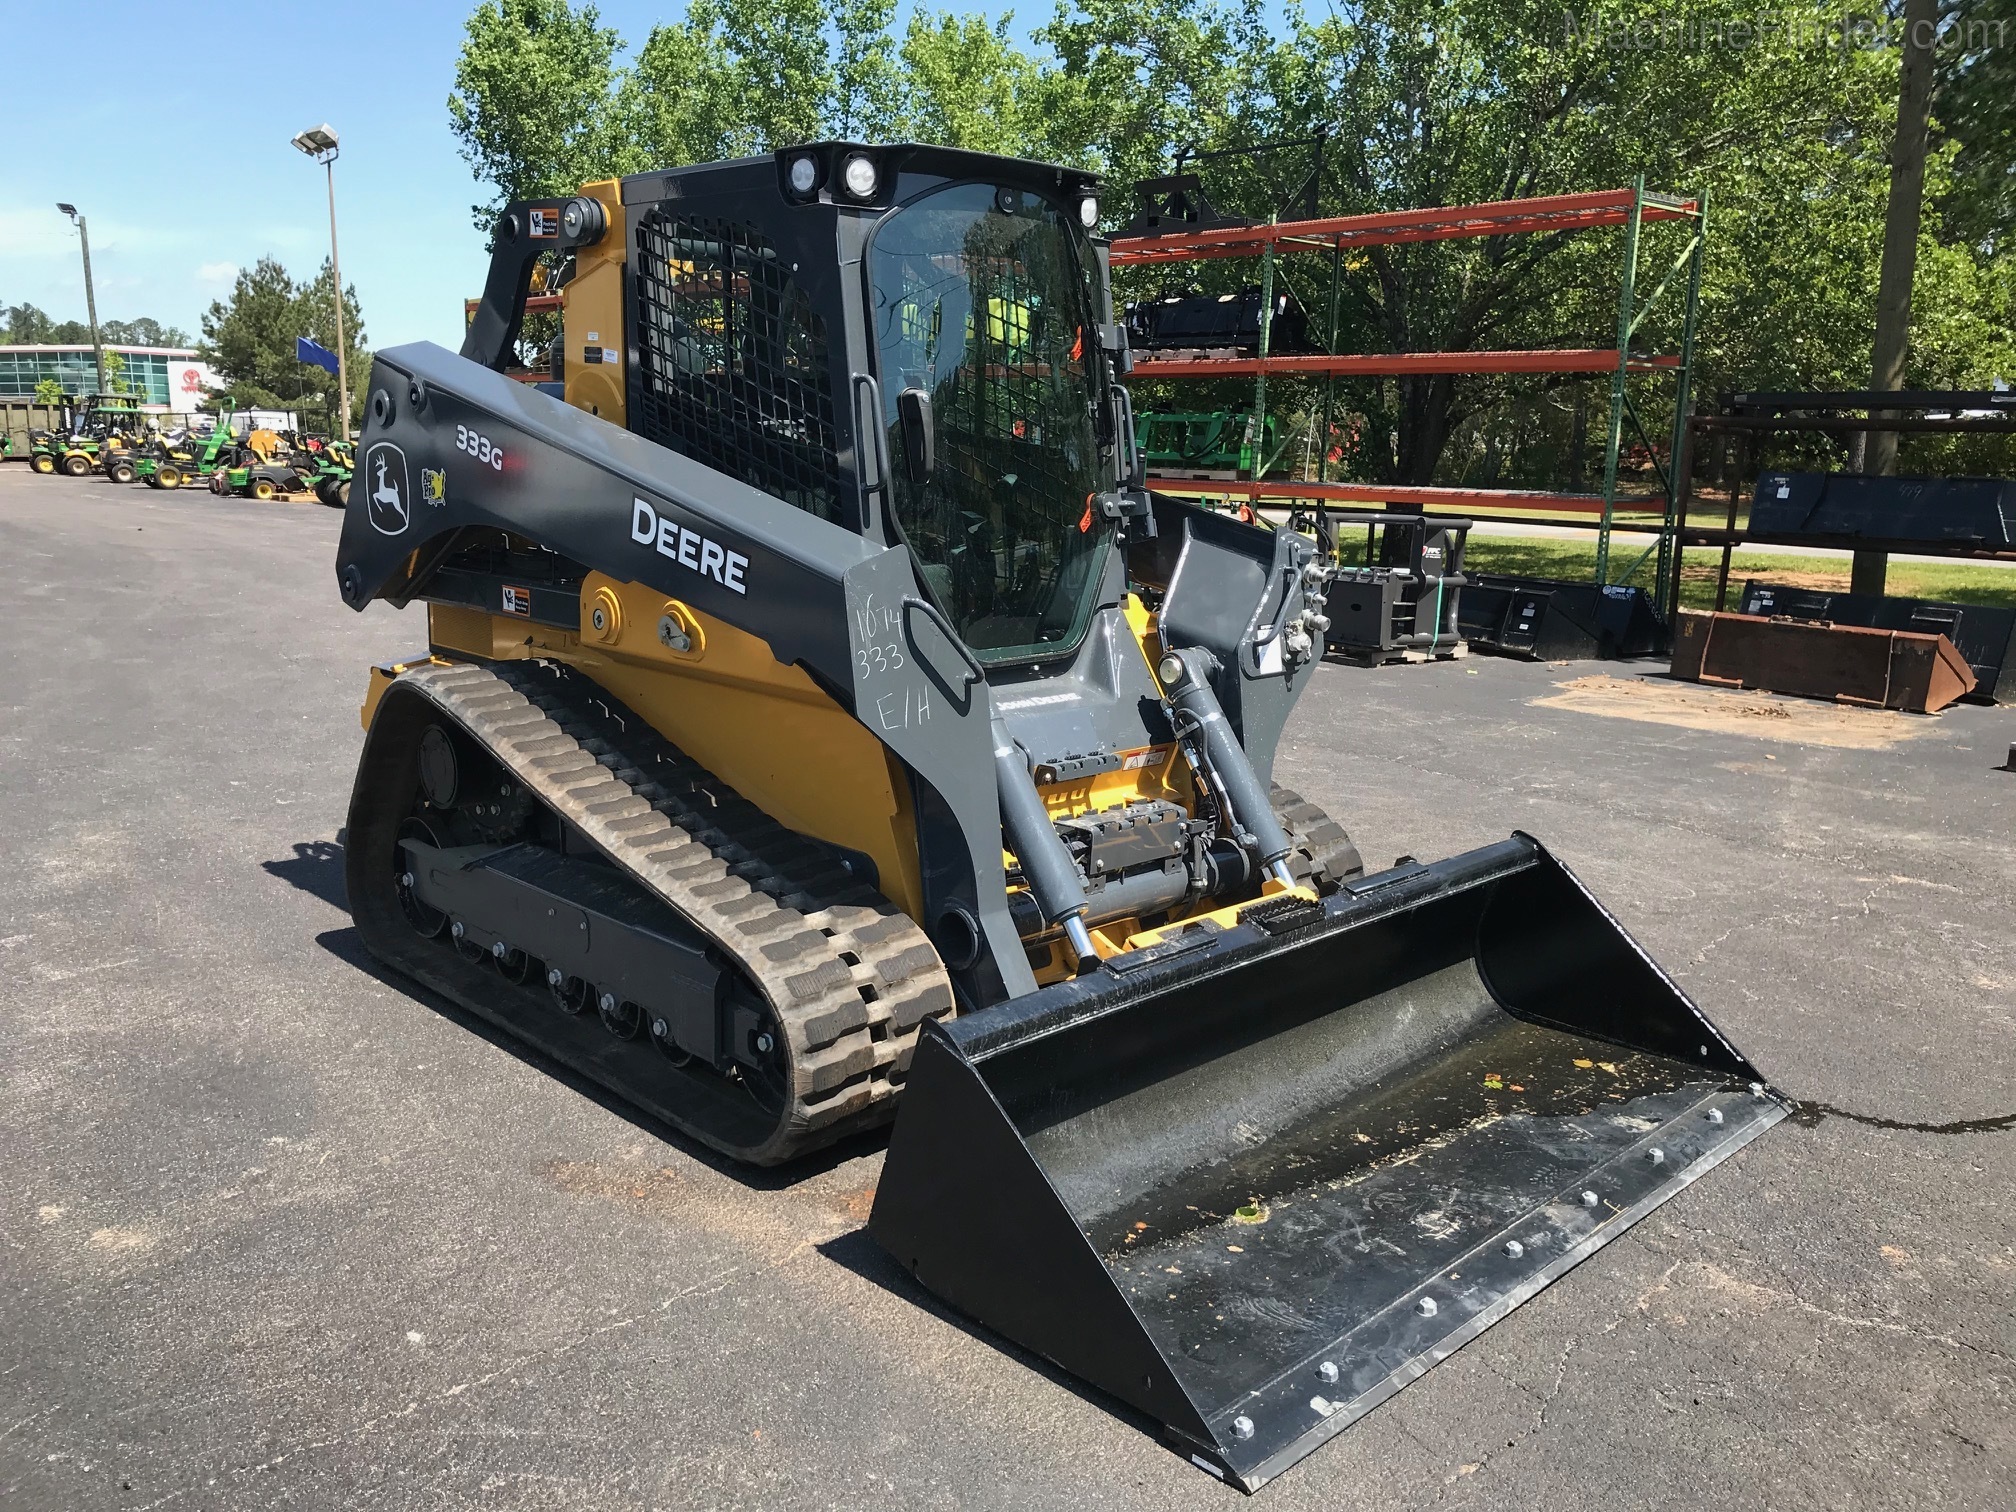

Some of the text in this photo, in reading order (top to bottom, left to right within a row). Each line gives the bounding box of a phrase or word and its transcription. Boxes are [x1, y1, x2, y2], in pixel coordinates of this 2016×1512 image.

[456, 424, 503, 471] 333G
[631, 497, 749, 595] DEERE
[857, 644, 904, 680] 333
